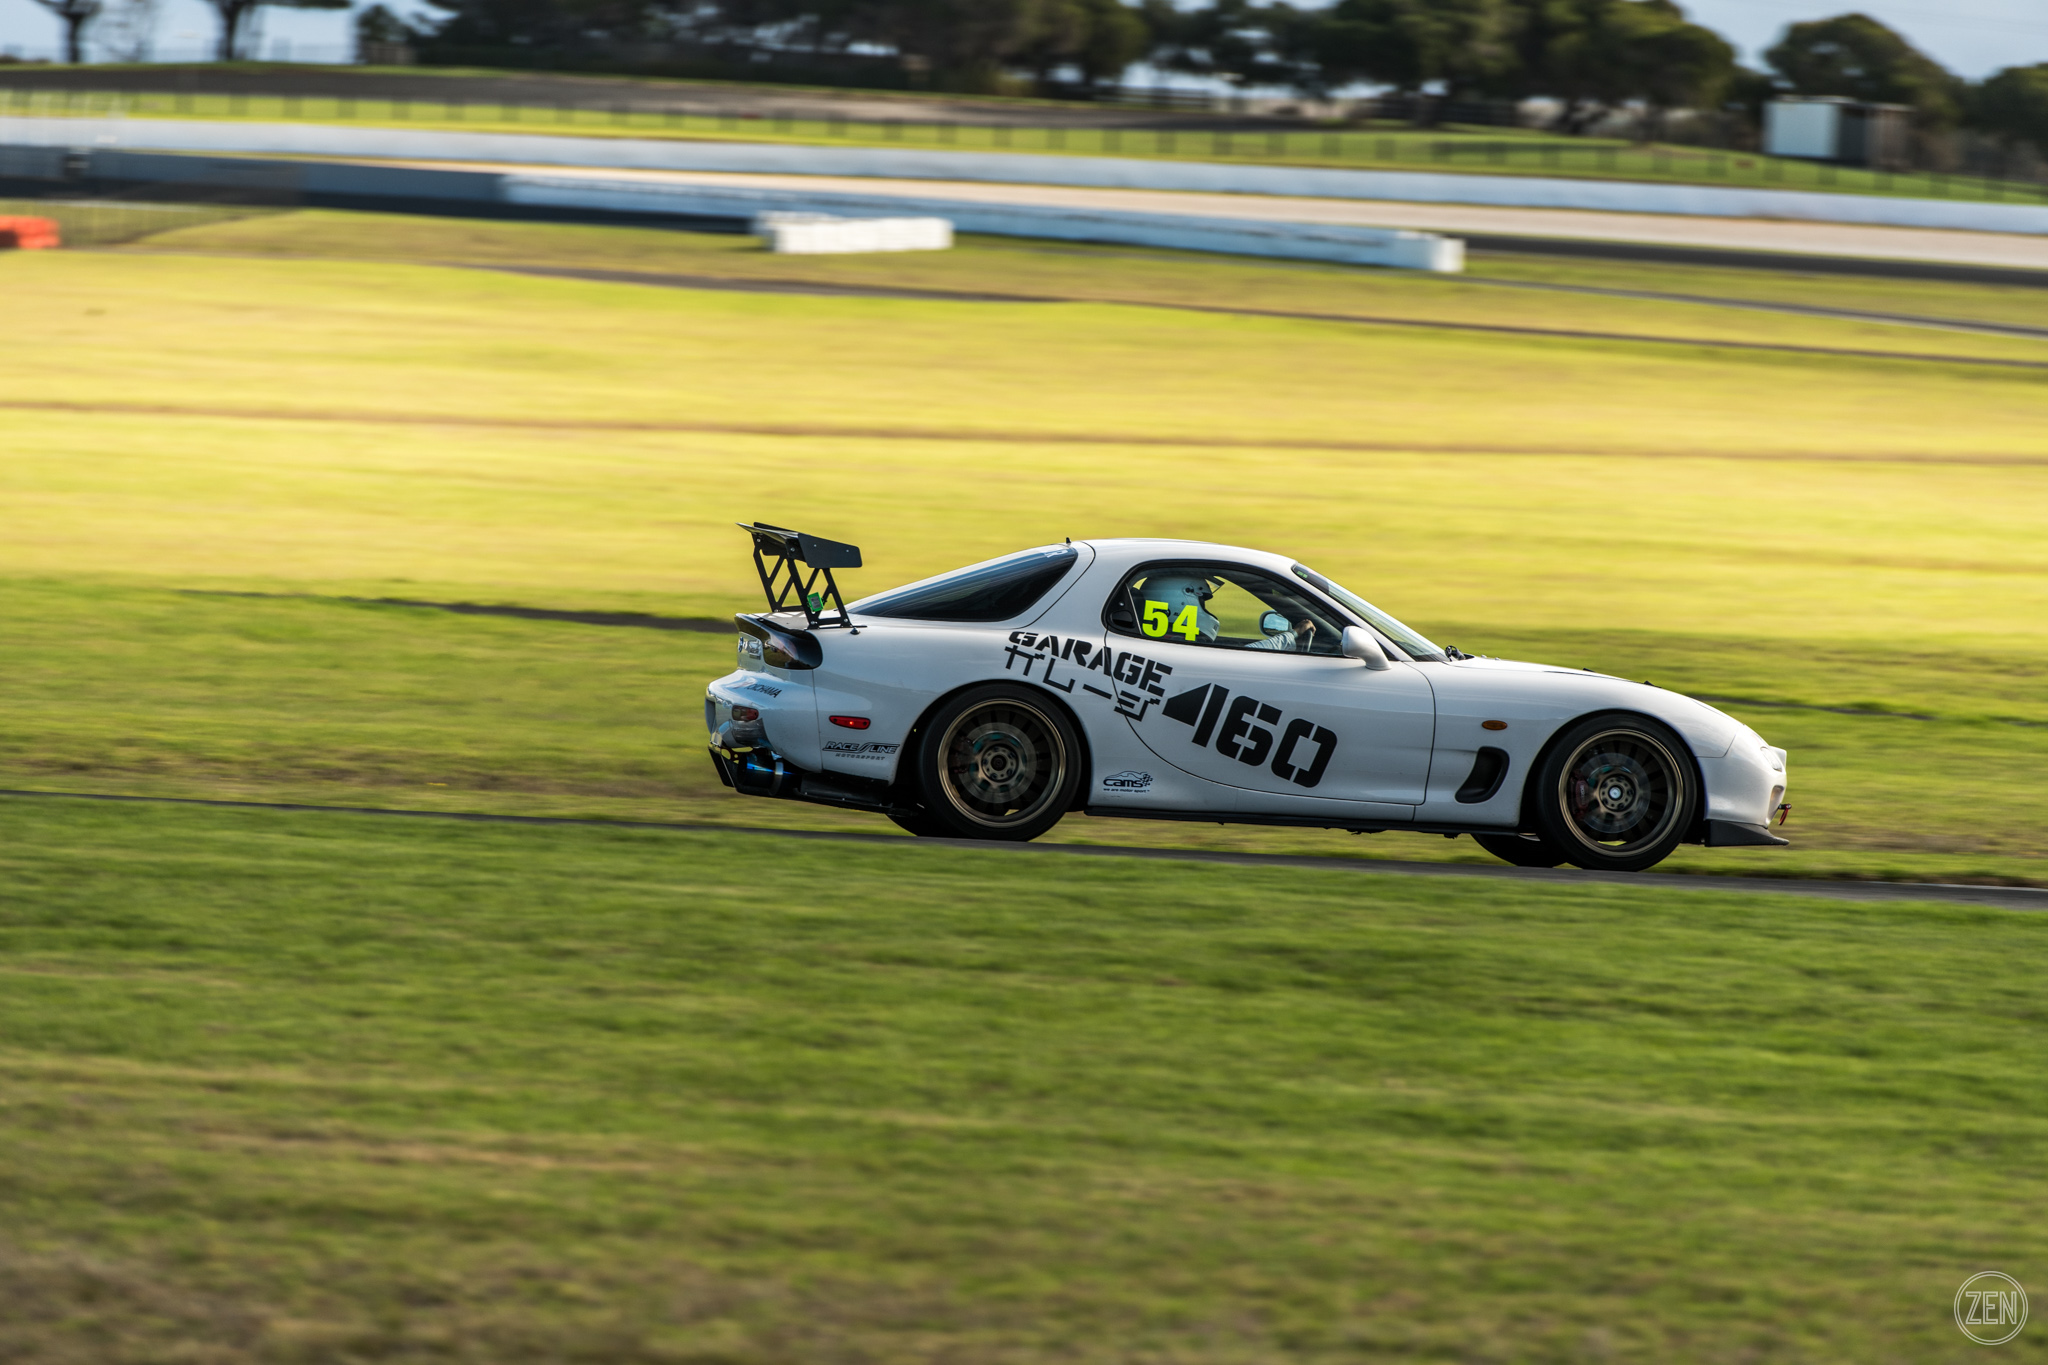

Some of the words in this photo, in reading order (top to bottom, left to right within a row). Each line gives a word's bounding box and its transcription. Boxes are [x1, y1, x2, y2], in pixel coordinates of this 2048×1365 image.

[1142, 599, 1200, 643] 54
[1004, 644, 1161, 722] ガレージ
[1008, 630, 1173, 698] GARAGE
[825, 741, 859, 752] RACE
[868, 743, 898, 754] LINE
[835, 753, 886, 761] MOTORSPORT
[1161, 682, 1338, 788] 460
